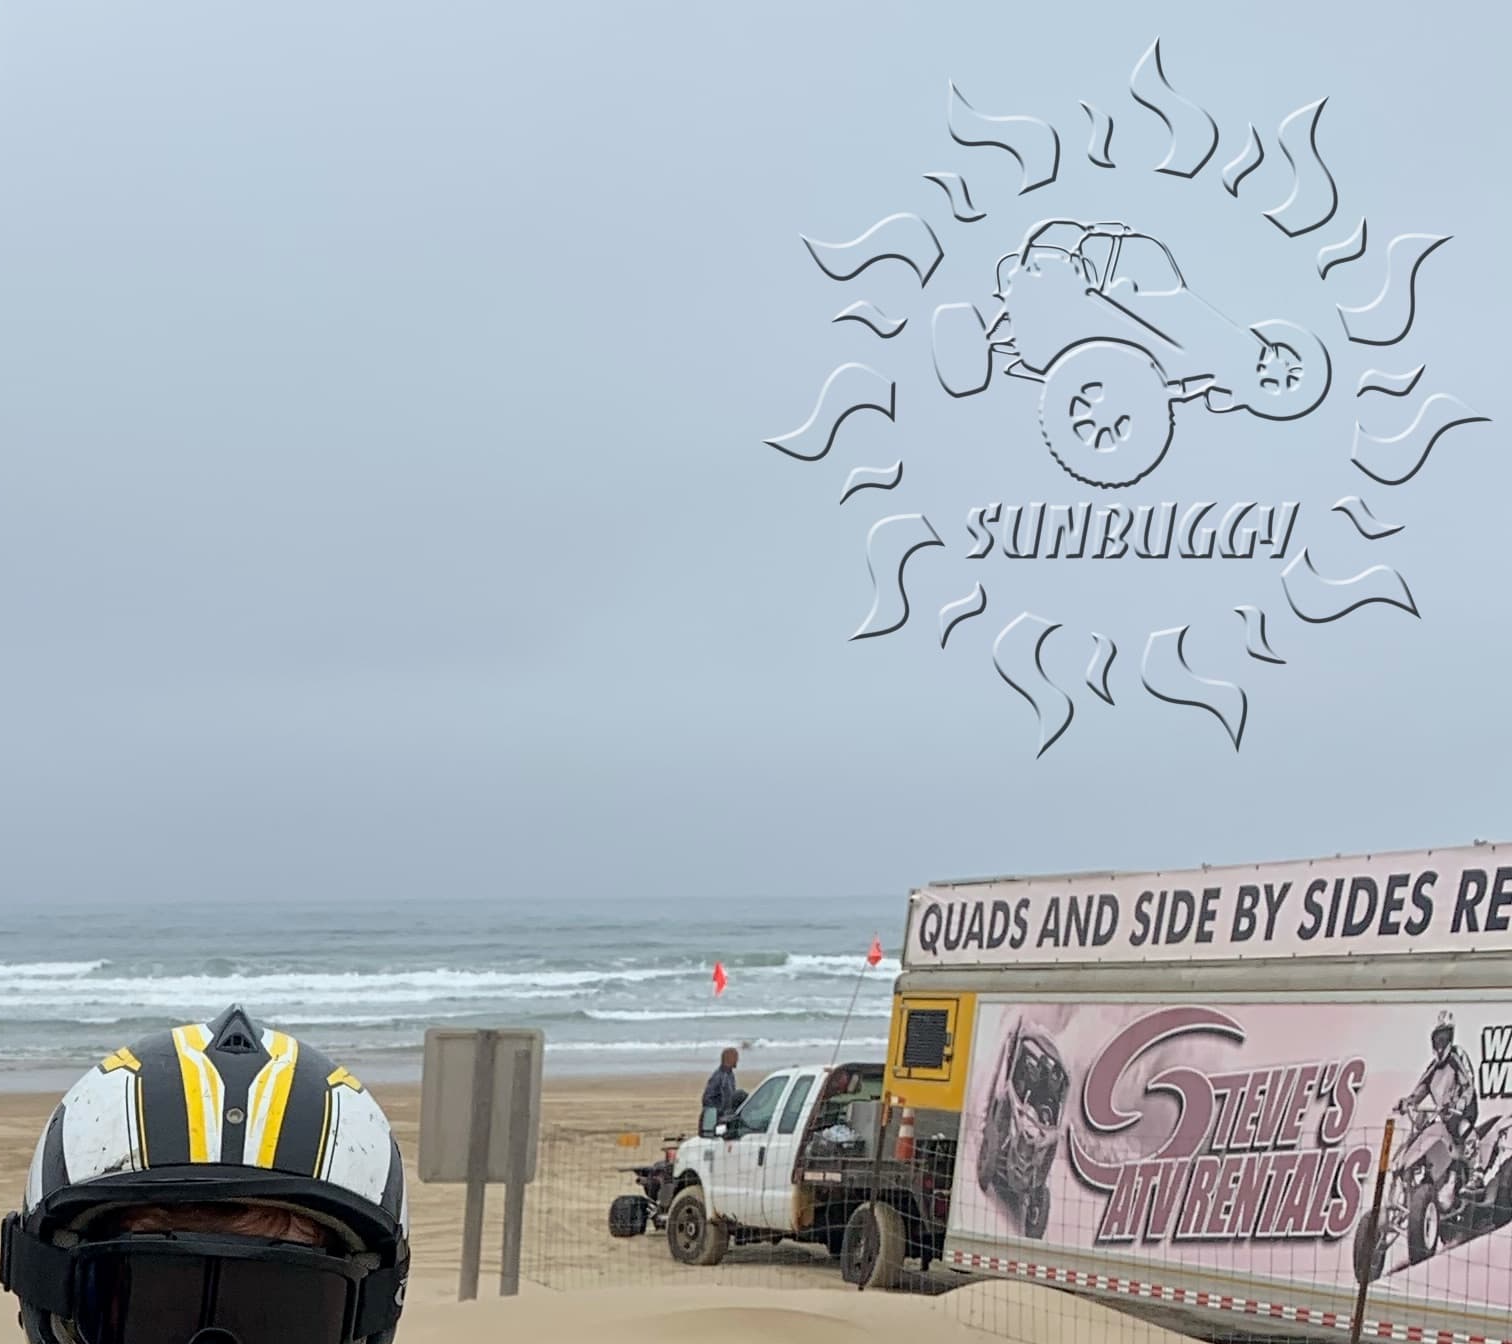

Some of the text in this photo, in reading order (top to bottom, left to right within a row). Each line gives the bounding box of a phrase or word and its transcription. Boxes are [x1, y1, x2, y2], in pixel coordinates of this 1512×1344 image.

[919, 897, 1031, 956] QUADS
[1036, 893, 1120, 948] AND
[1129, 887, 1221, 946] SIDE
[1230, 882, 1293, 942] BY
[1297, 870, 1439, 940] SIDES
[1068, 1004, 1368, 1190] STEVE'S
[1096, 1147, 1374, 1241] ATV RENTALS
